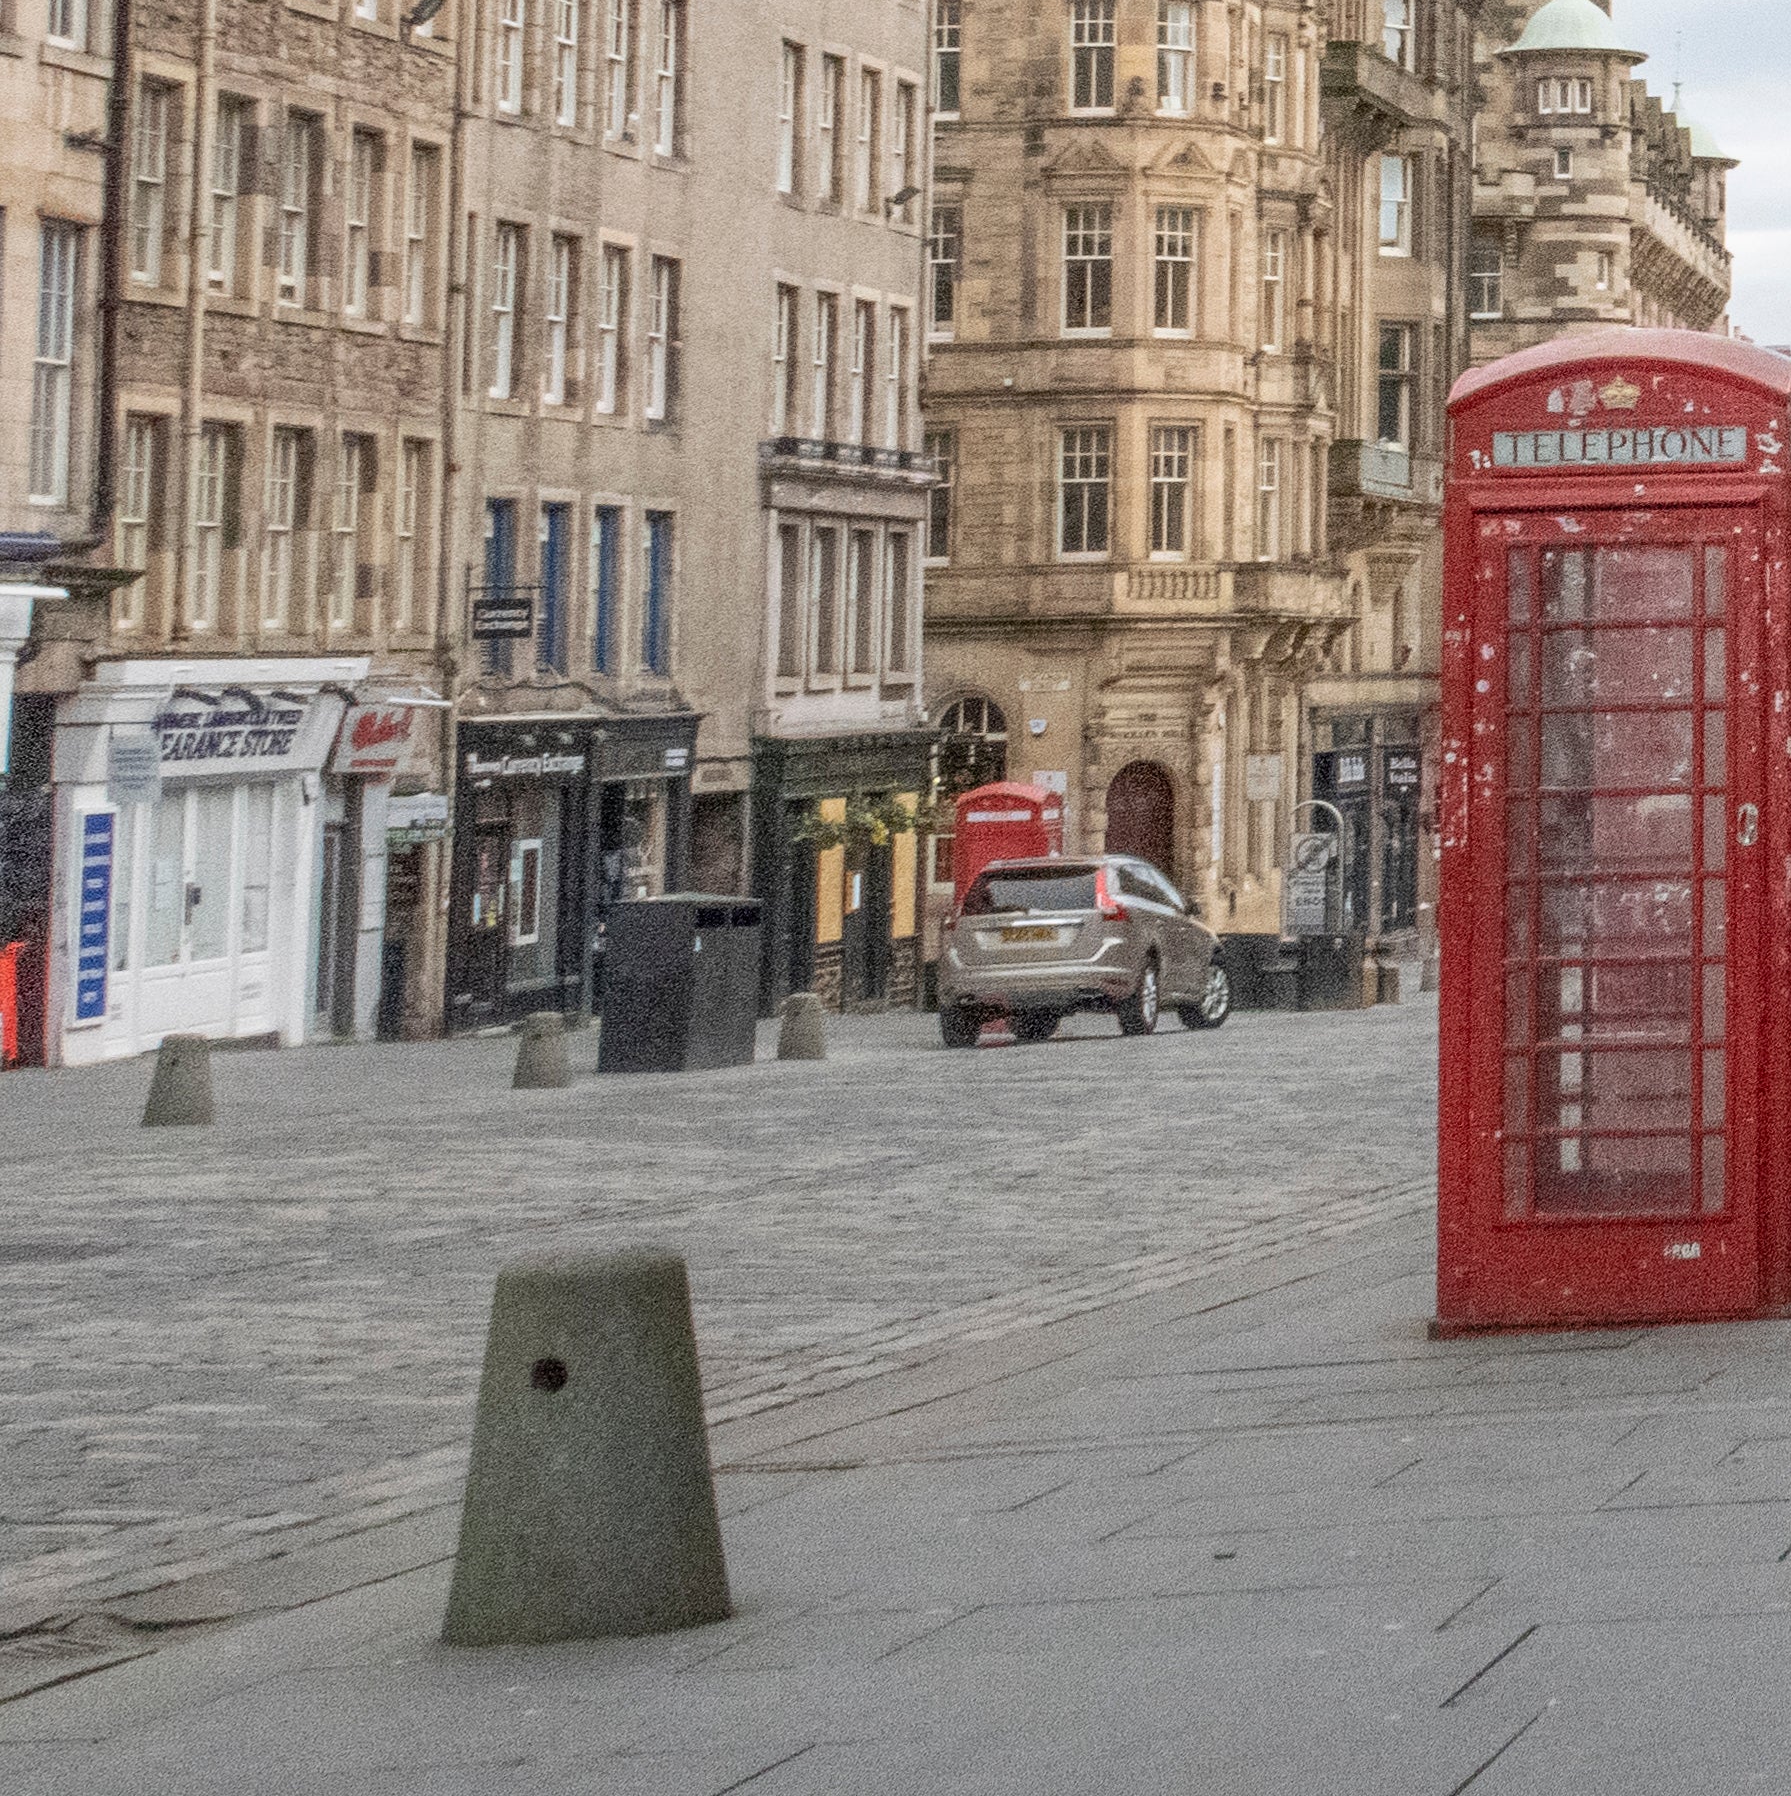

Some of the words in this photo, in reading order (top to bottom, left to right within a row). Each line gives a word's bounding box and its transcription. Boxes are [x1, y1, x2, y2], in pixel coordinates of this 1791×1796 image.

[1504, 427, 1736, 464] TELEPHONE
[162, 729, 244, 762] EARANCE
[241, 727, 297, 758] STORE
